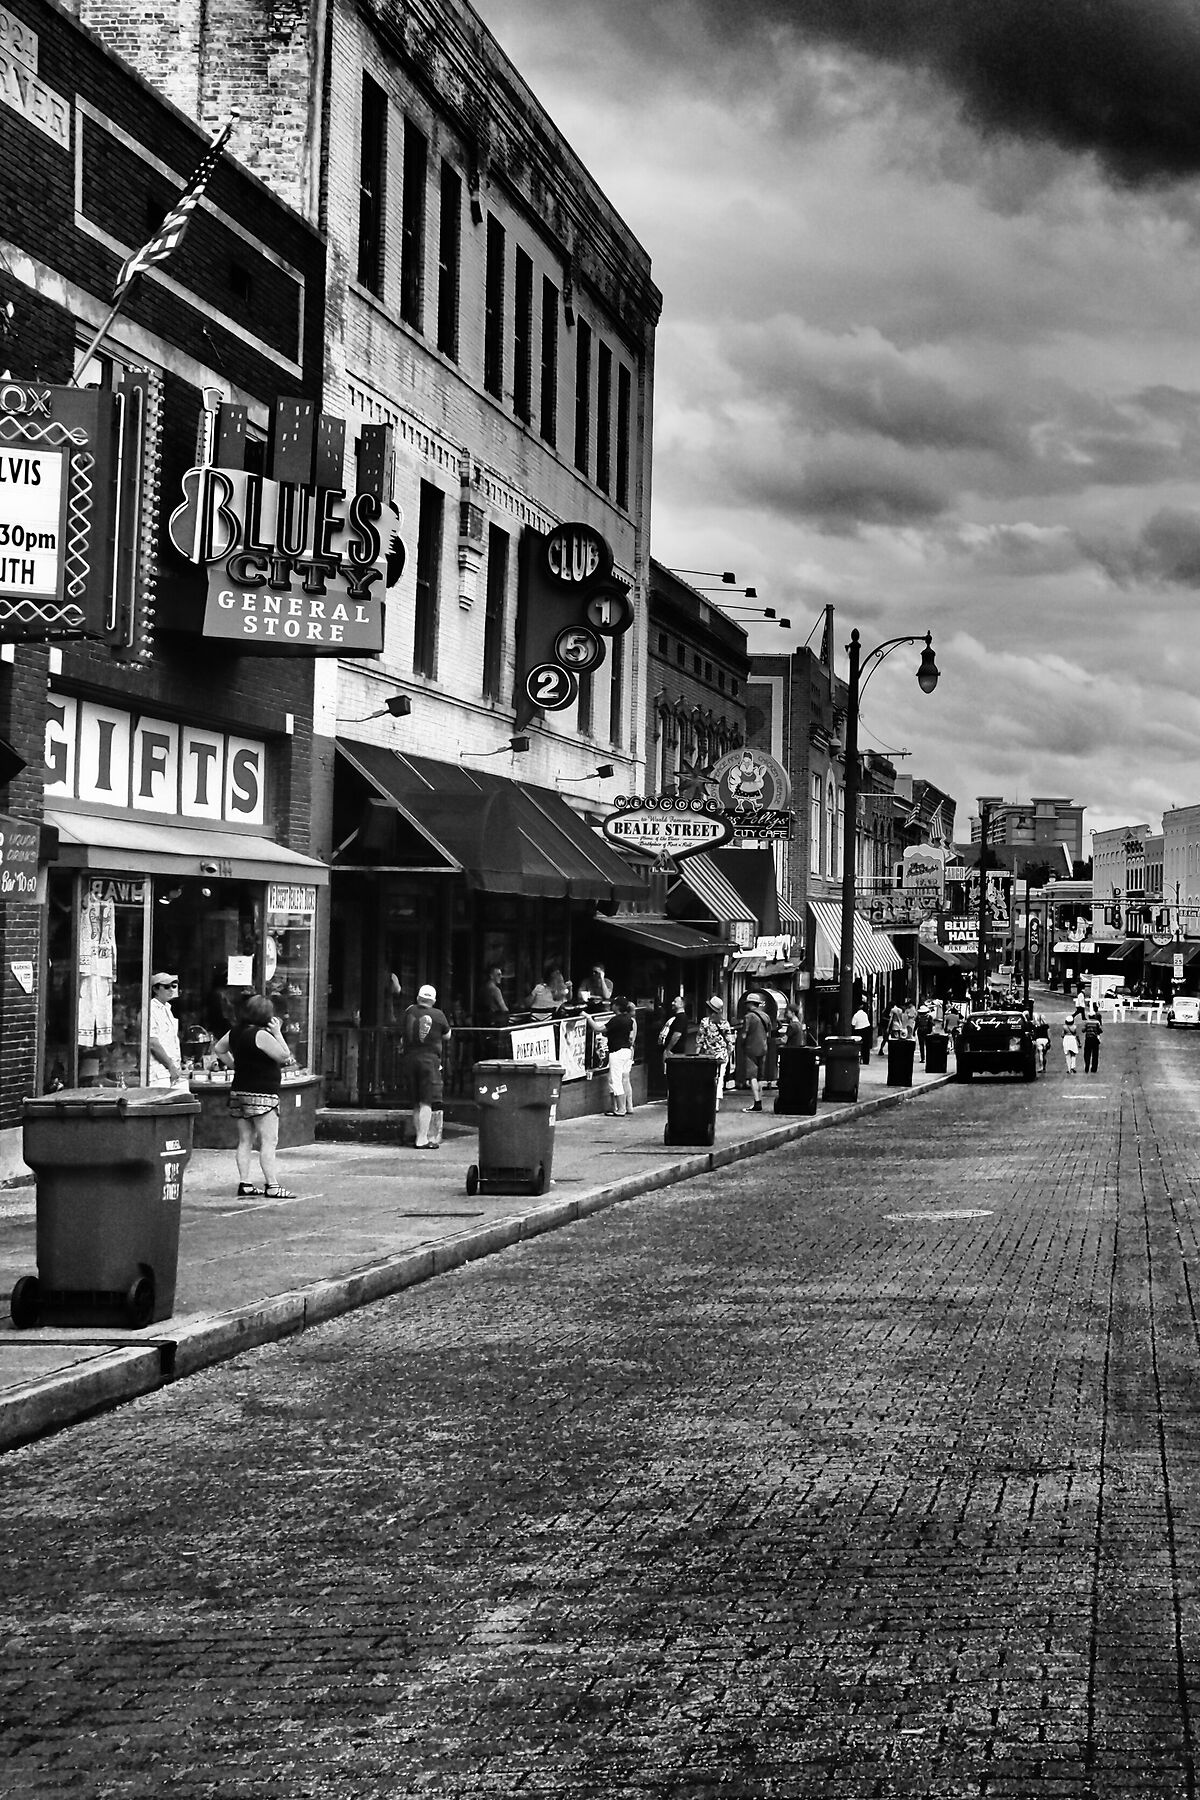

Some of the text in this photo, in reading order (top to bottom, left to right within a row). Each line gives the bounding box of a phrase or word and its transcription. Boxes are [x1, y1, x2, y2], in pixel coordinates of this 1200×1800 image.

[204, 470, 382, 565] BLUES
[548, 533, 600, 582] CLUB
[226, 551, 383, 601] CITY
[218, 590, 370, 624] GENERAL
[243, 615, 345, 642] STORE
[44, 702, 260, 814] GIFTS
[615, 796, 718, 812] WELCOME
[613, 822, 720, 838] BEALE STREET
[758, 829, 788, 839] CAFE
[948, 931, 980, 941] HALL
